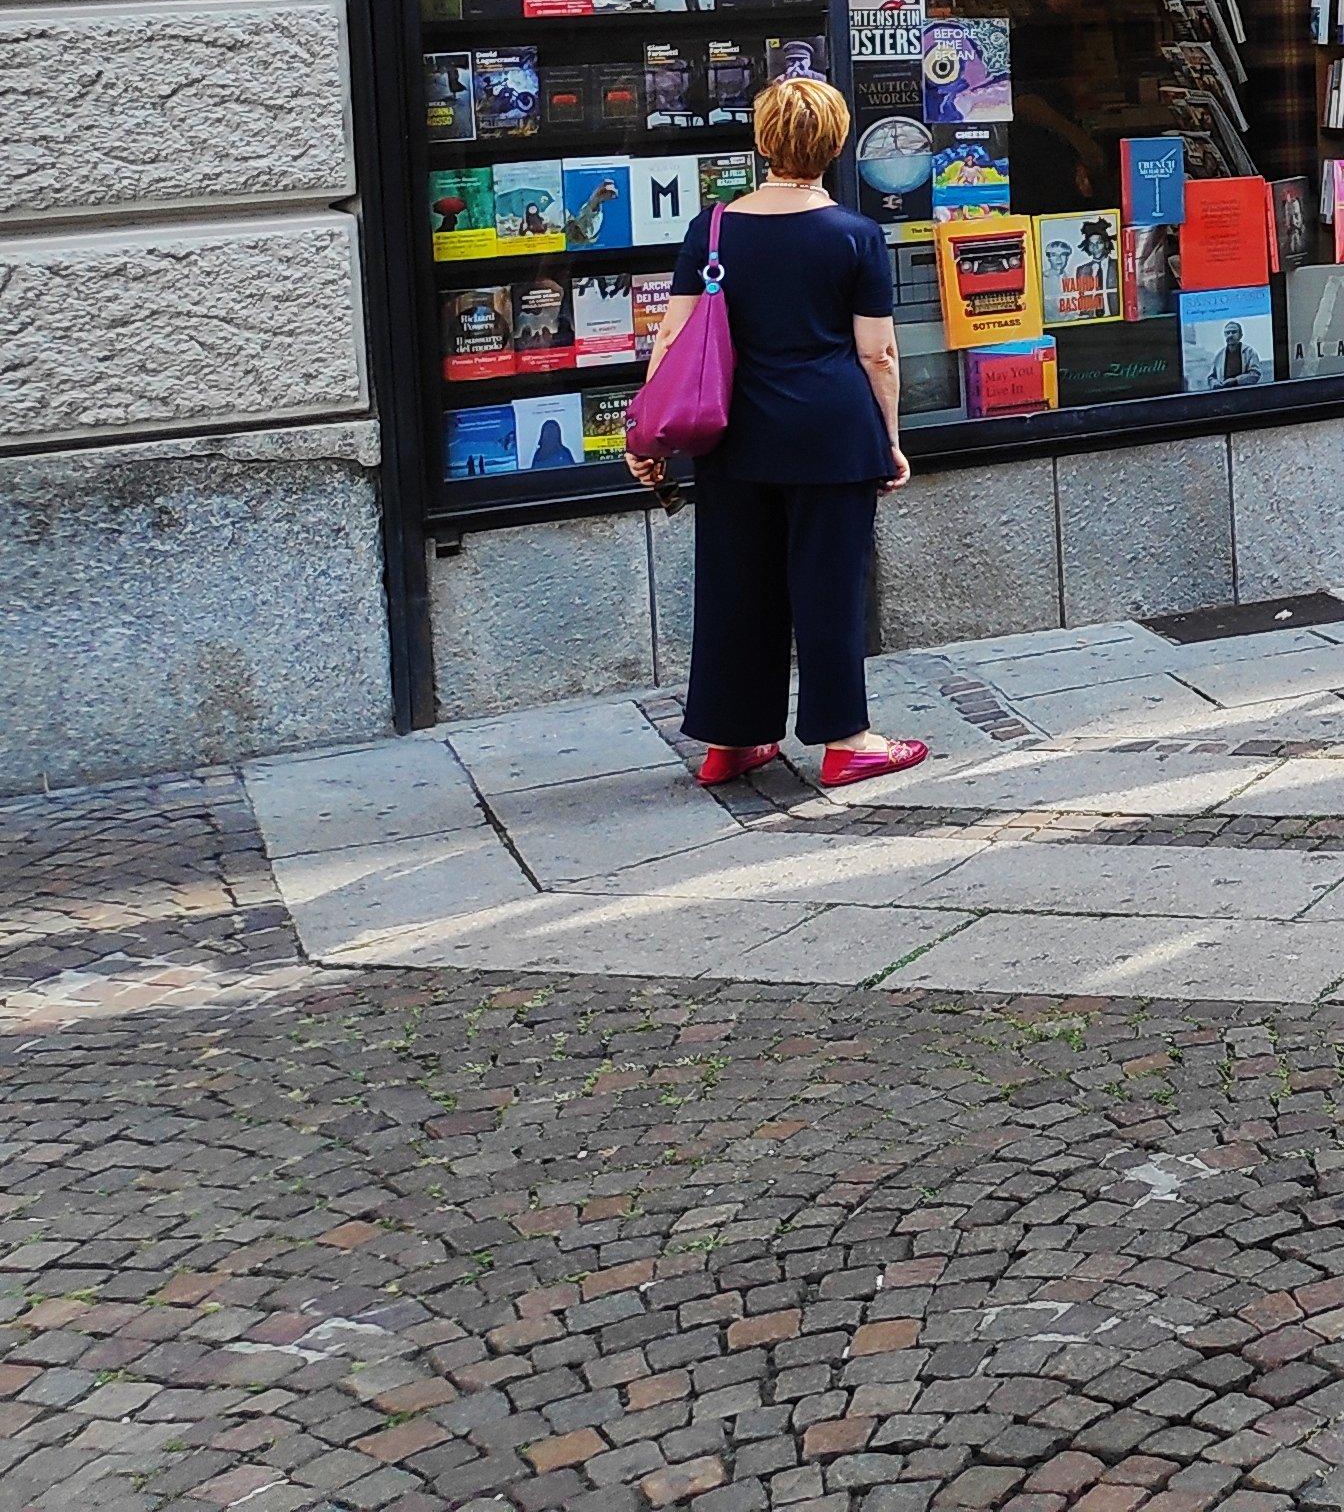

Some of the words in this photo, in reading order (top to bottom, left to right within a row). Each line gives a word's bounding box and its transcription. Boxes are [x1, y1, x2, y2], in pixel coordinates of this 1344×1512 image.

[934, 28, 977, 39] BEFORE
[935, 39, 963, 50] TIME
[935, 49, 976, 61] BEGAN
[868, 91, 920, 105] WORKS
[650, 174, 680, 219] M
[636, 293, 651, 303] DEI
[1010, 364, 1034, 378] You
